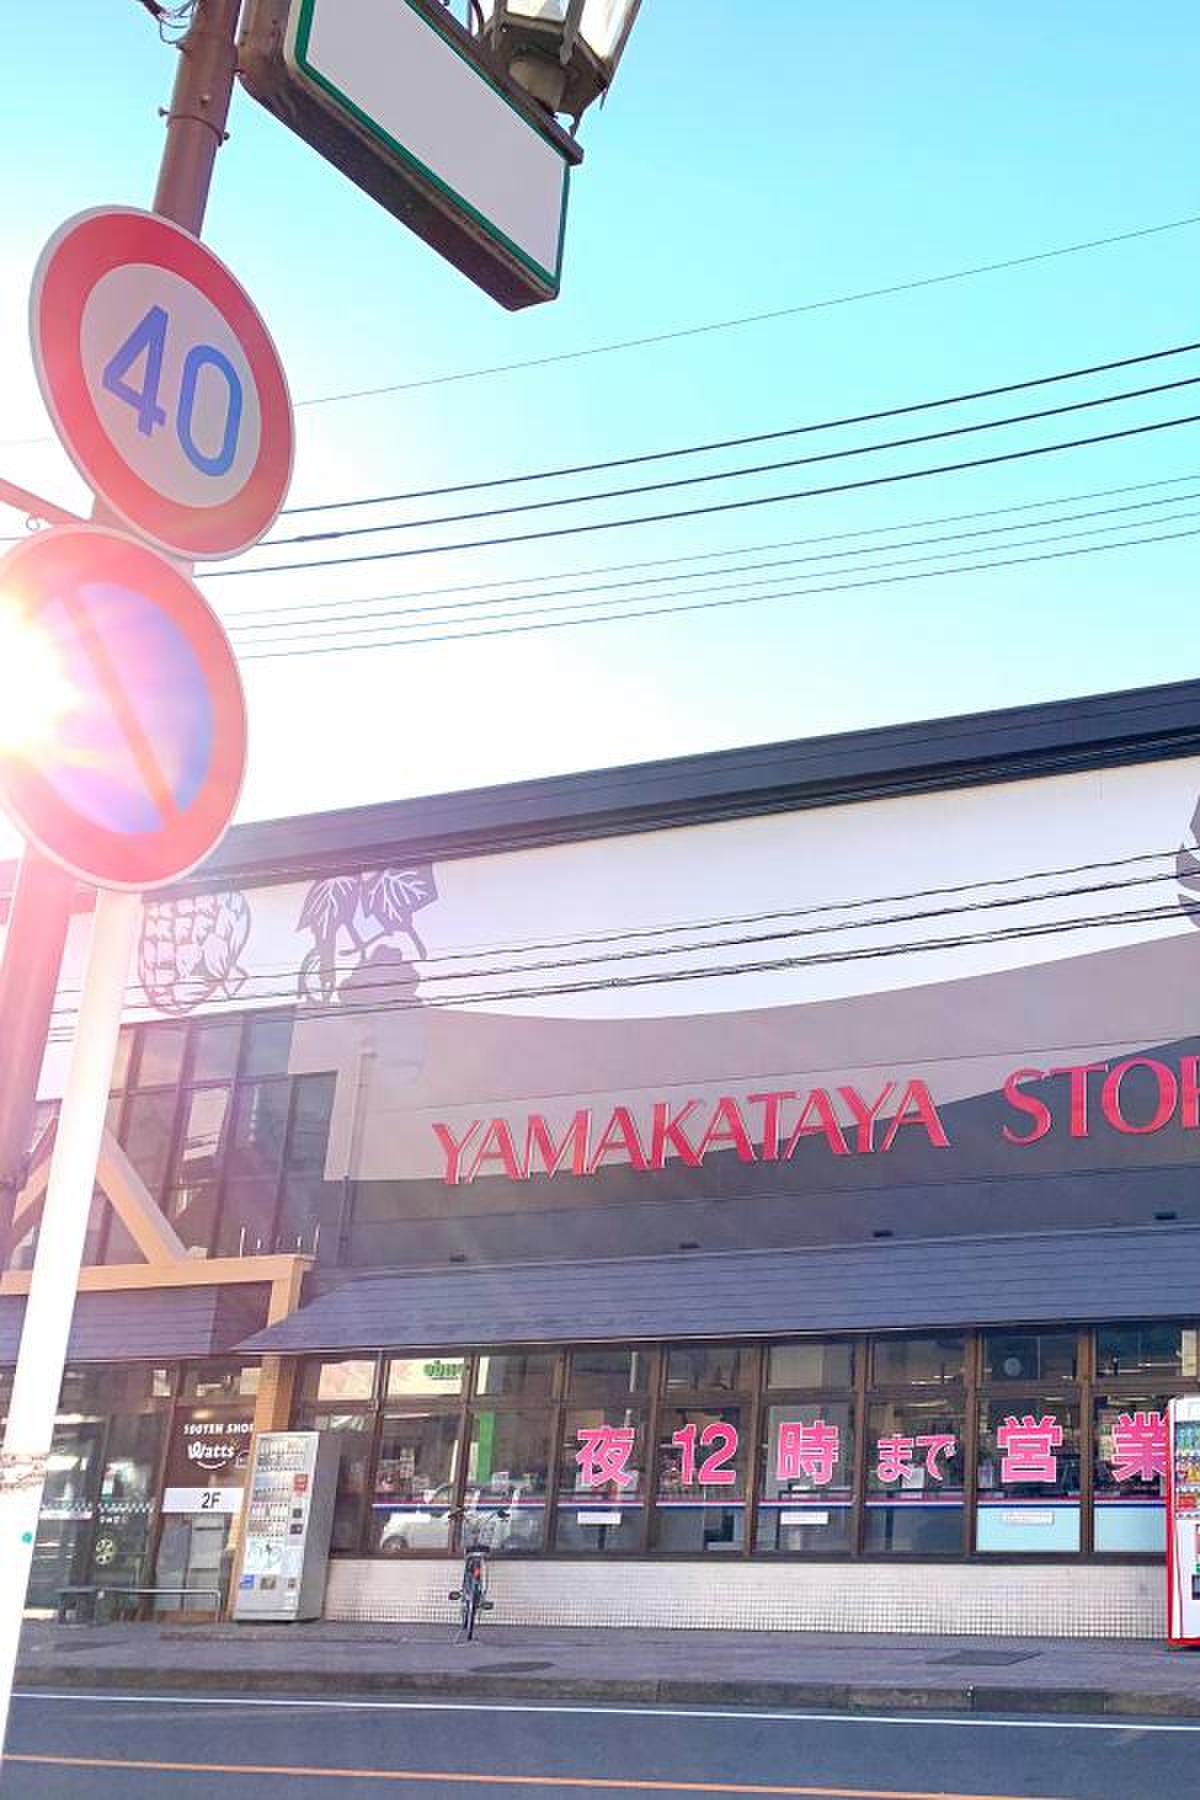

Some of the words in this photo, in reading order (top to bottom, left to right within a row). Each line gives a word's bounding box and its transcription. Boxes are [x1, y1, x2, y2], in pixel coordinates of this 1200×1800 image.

[102, 305, 243, 477] 40
[432, 1078, 951, 1184] YAMAKATAYA
[188, 1441, 235, 1460] Watts
[201, 1491, 222, 1509] 2F
